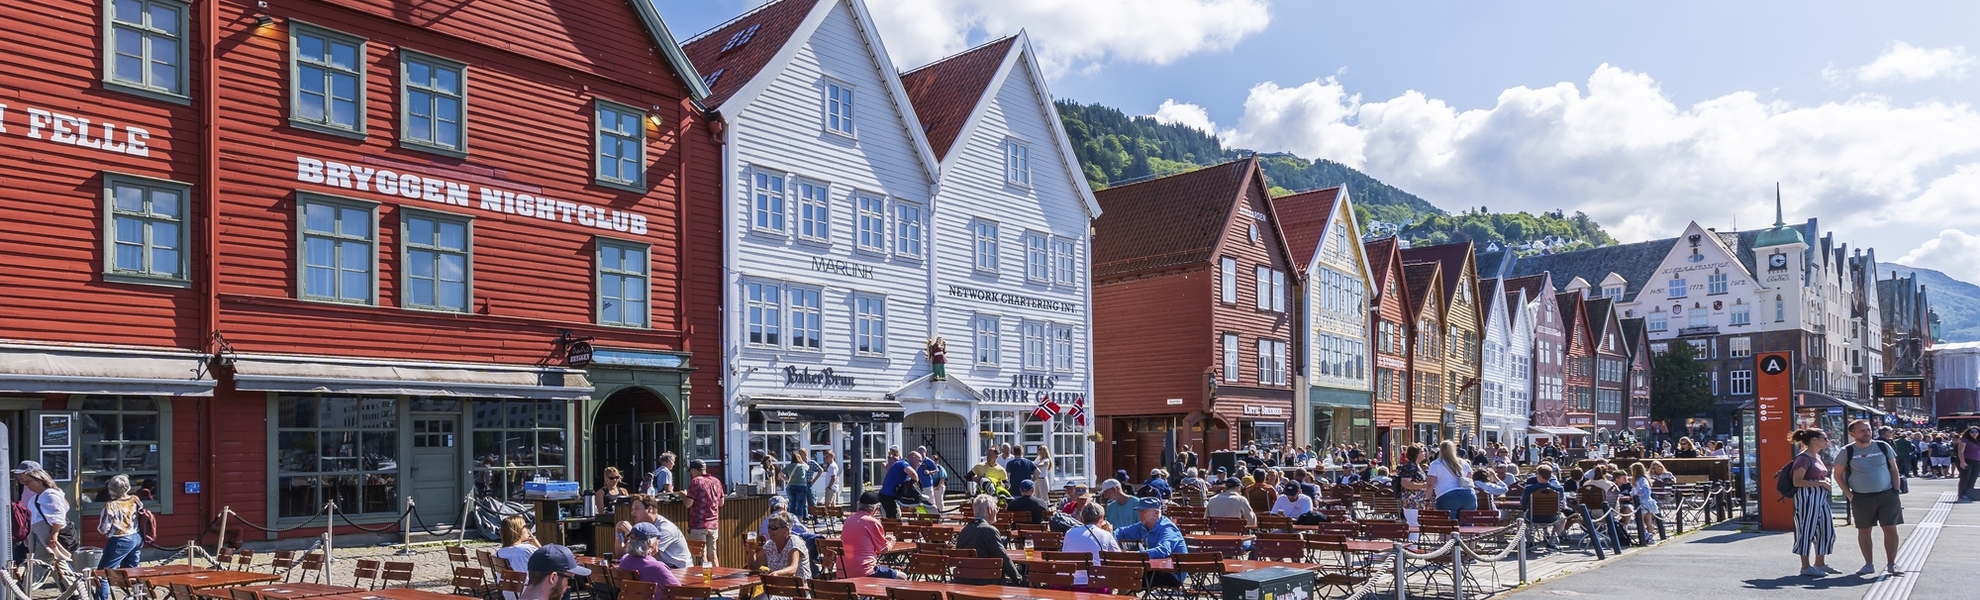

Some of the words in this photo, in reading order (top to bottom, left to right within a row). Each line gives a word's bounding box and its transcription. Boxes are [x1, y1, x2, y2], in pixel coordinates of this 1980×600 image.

[27, 107, 150, 157] FELLE
[296, 156, 470, 207] BRYGGEN
[479, 187, 648, 236] NIGHTCLUB
[811, 256, 874, 280] MARLINK
[948, 285, 998, 303] NETWORK
[1000, 293, 1059, 312] CHARTERING
[1060, 303, 1078, 314] INT.
[1766, 359, 1781, 372] A
[982, 387, 1029, 403] SILVER
